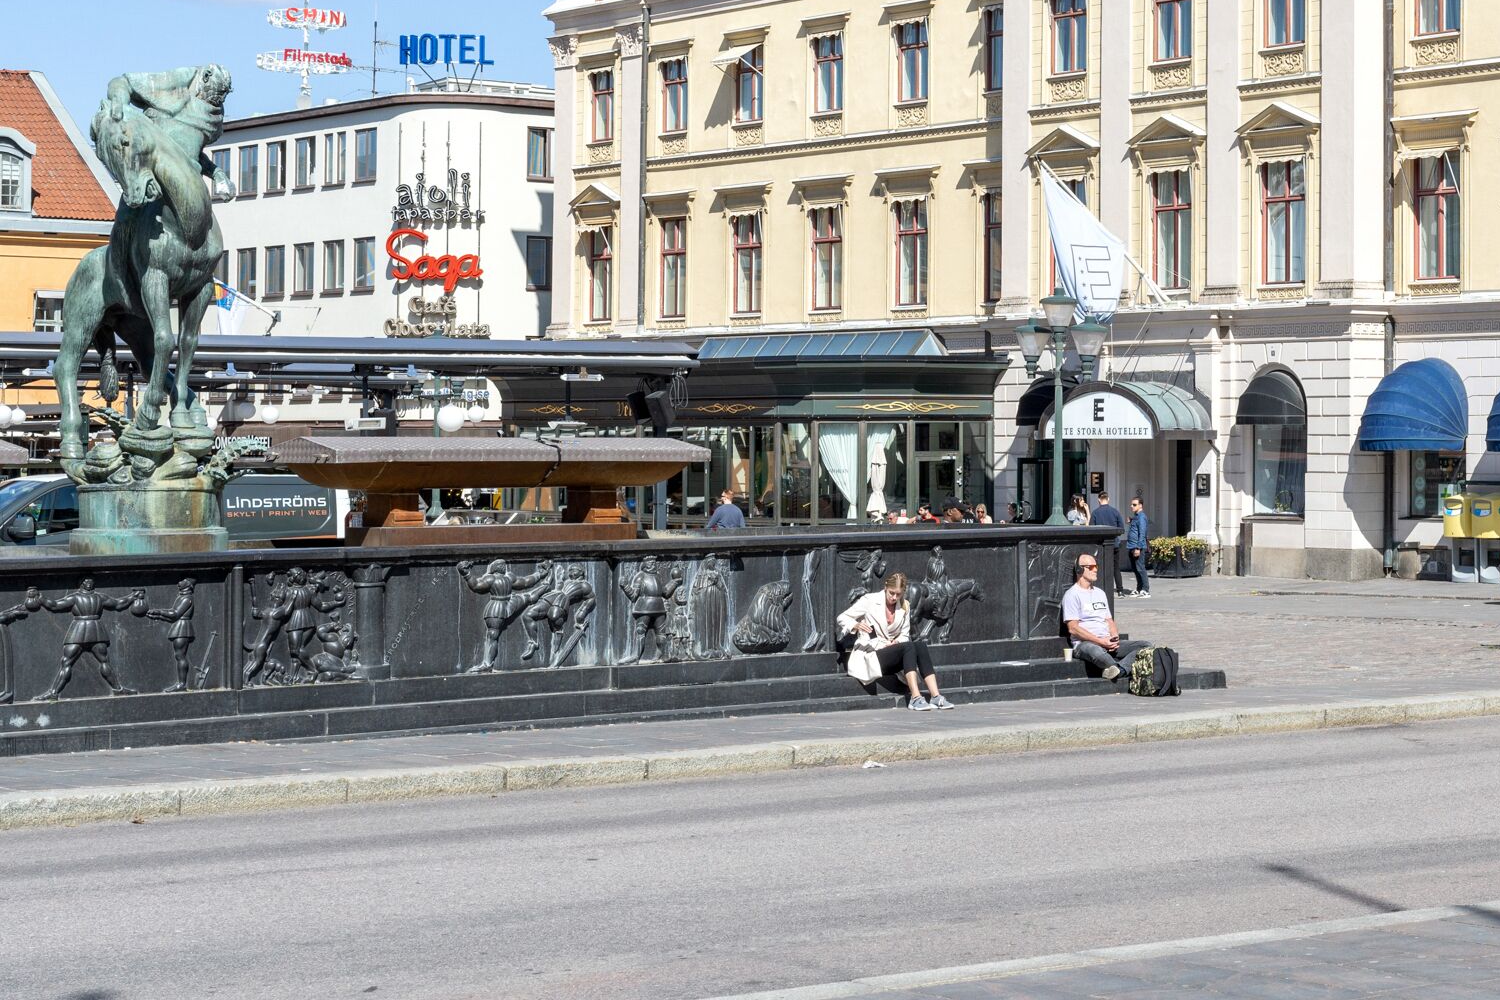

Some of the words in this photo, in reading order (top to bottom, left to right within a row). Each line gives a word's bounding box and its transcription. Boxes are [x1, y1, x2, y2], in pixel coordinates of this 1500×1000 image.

[400, 34, 494, 65] HOTEL
[396, 168, 470, 207] aioli
[386, 228, 484, 292] Saga
[408, 295, 457, 316] Café
[1051, 427, 1074, 436] ETE
[1077, 427, 1102, 436] STORA
[1106, 427, 1149, 436] HOTELLET
